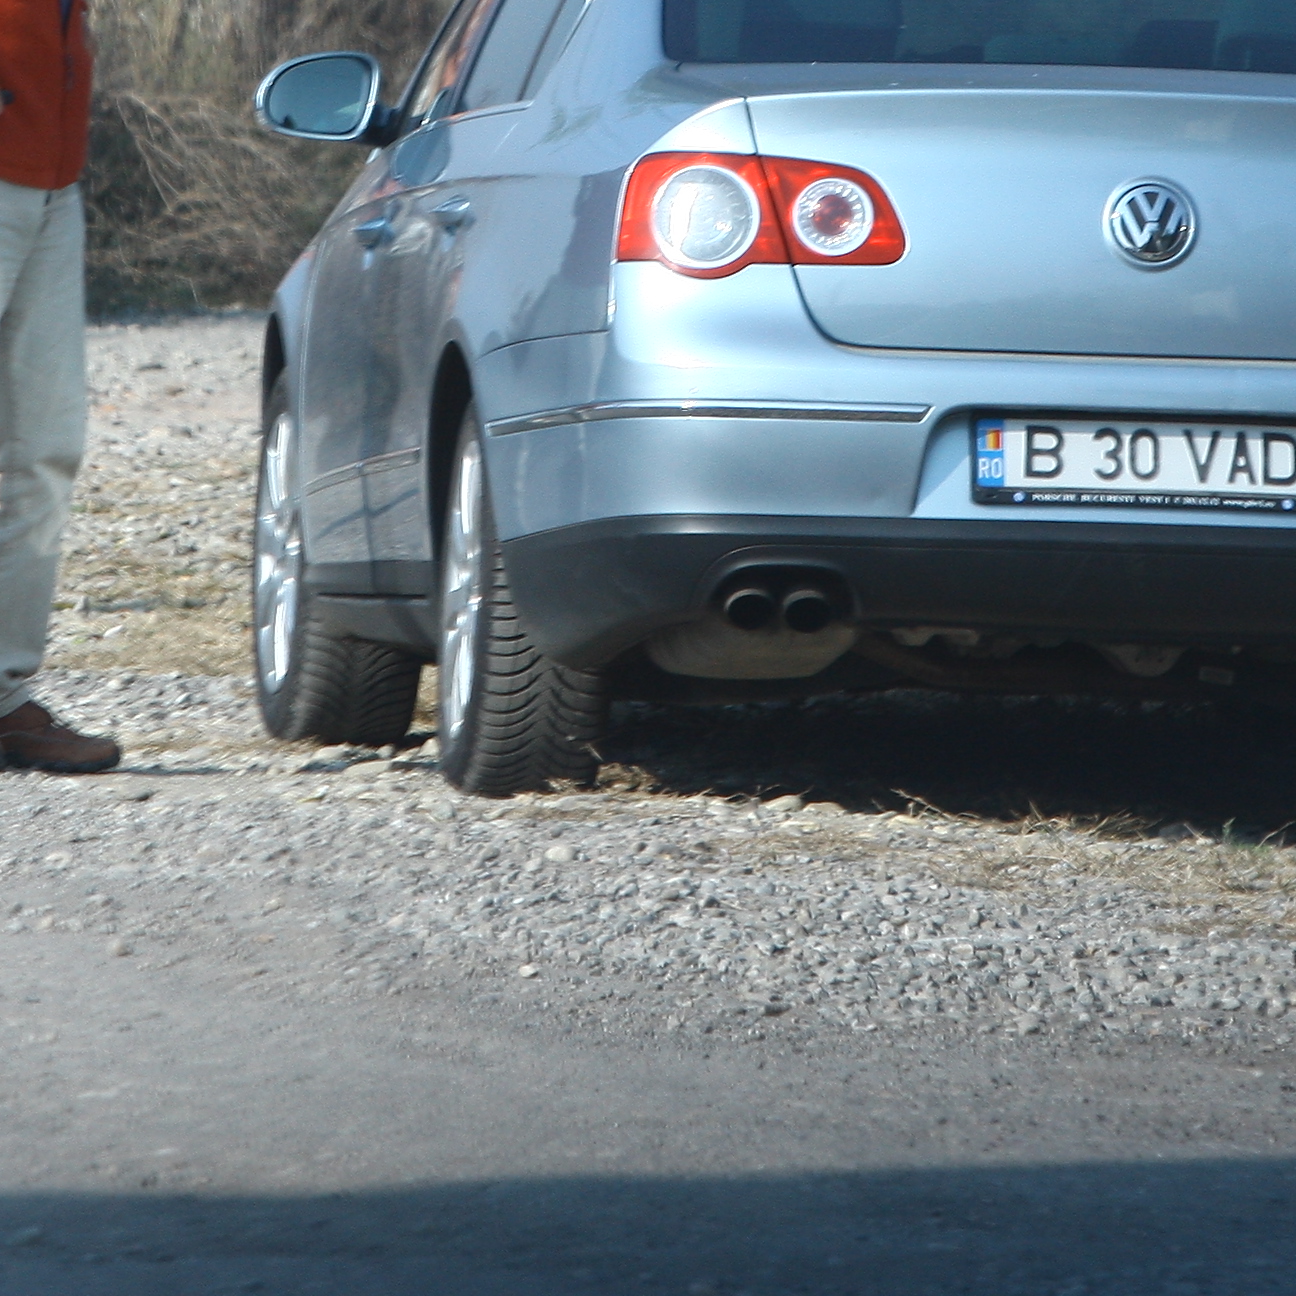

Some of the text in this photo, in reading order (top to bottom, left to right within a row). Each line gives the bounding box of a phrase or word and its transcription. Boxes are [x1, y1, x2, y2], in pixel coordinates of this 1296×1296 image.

[978, 457, 1003, 479] RO
[1025, 425, 1064, 478] B
[1092, 427, 1160, 481] 30
